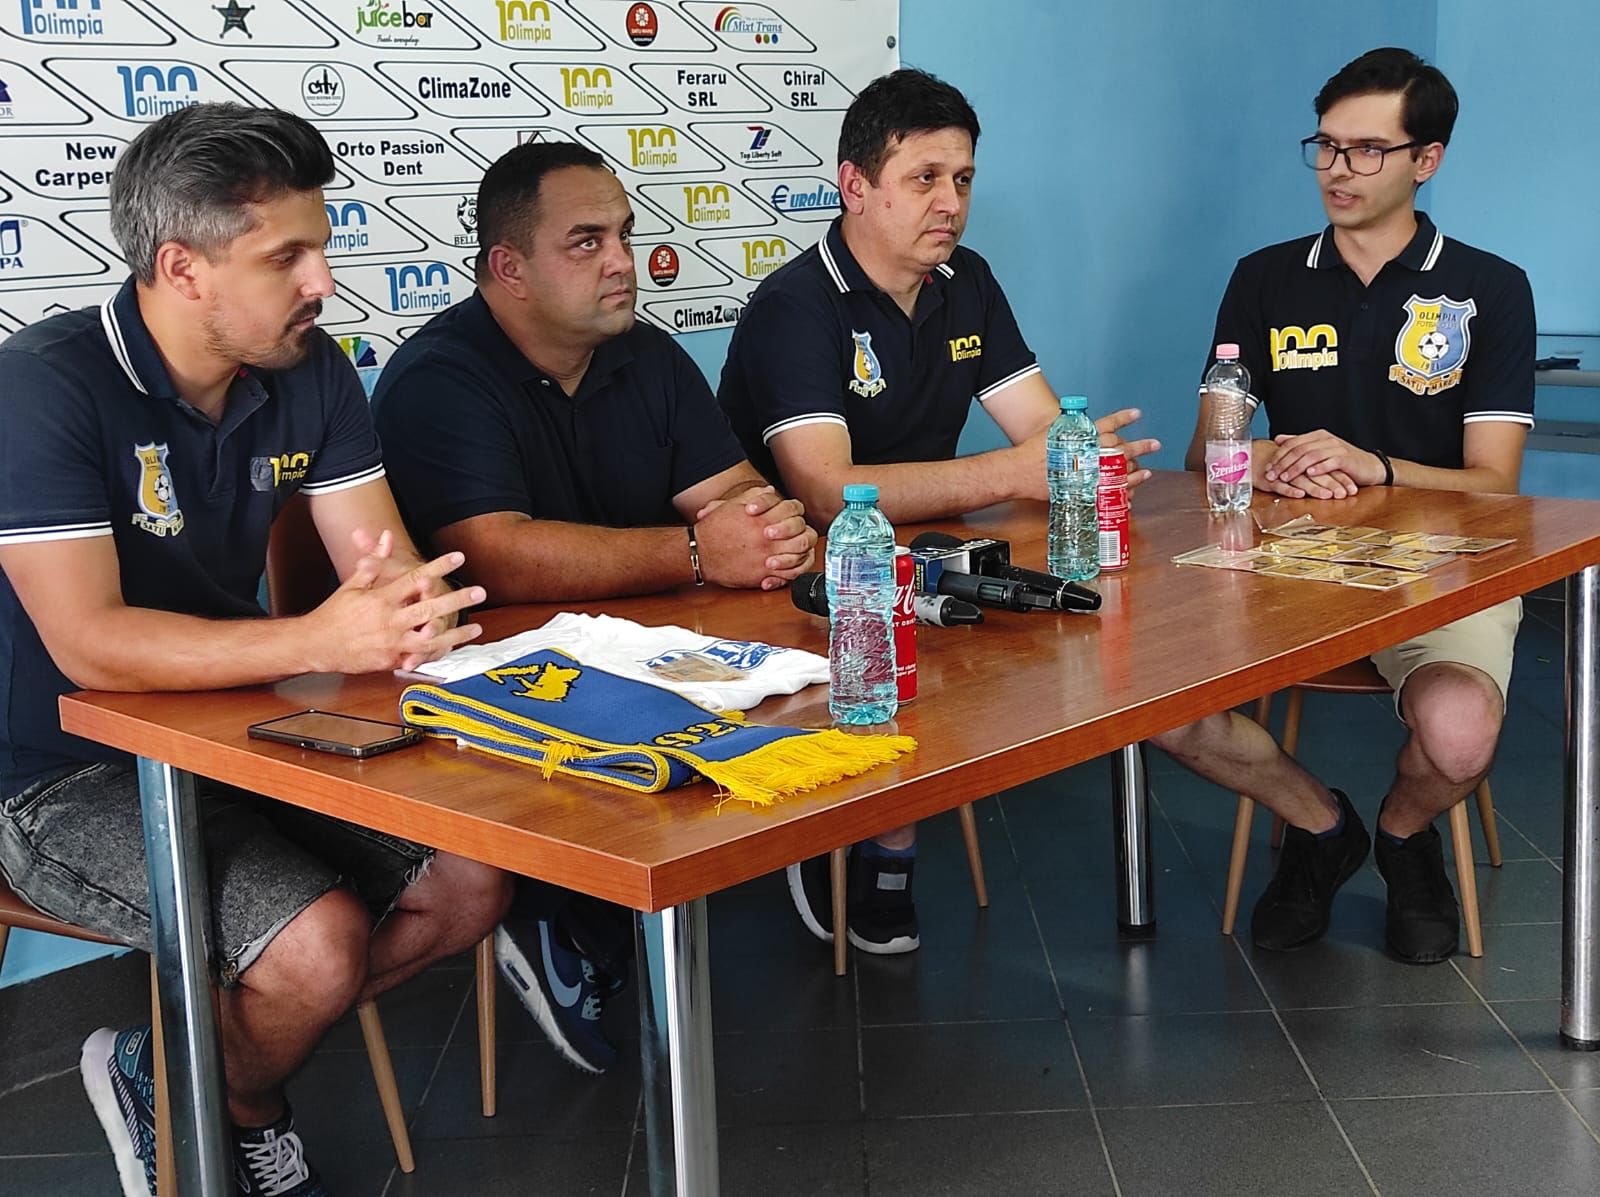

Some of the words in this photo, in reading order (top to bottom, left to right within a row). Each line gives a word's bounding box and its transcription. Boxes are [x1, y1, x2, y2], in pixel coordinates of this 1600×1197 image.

[33, 13, 104, 39] Olimpia
[495, 0, 550, 41] 100
[733, 20, 754, 32] Mixt
[757, 20, 782, 33] Trans
[508, 24, 551, 43] Olimpia
[677, 70, 727, 85] Feraru
[783, 70, 825, 86] Chiral
[117, 66, 198, 117] 100
[418, 77, 511, 99] ClimaZone
[560, 67, 612, 108] 100
[572, 91, 613, 109] Olimpia
[688, 92, 717, 107] SRL
[791, 92, 817, 107] SRL
[65, 143, 117, 160] New
[336, 141, 375, 157] Orto
[380, 140, 445, 155] Passion
[627, 127, 677, 167] 100
[740, 151, 751, 159] Top
[751, 150, 770, 159] Liberty
[771, 150, 782, 158] Soft
[639, 149, 677, 167] Olimpia
[383, 161, 423, 176] Dent
[683, 184, 730, 224] 100
[694, 205, 730, 226] Olimpia
[742, 239, 786, 277] 100
[384, 263, 450, 312] 100
[400, 289, 451, 311] Olimpia
[1419, 311, 1457, 321] OLIMPIA
[949, 335, 982, 362] 100
[956, 347, 982, 360] Olimpia
[1270, 324, 1338, 372] 100
[1279, 347, 1338, 371] Olimpia
[1401, 376, 1422, 392] SATU
